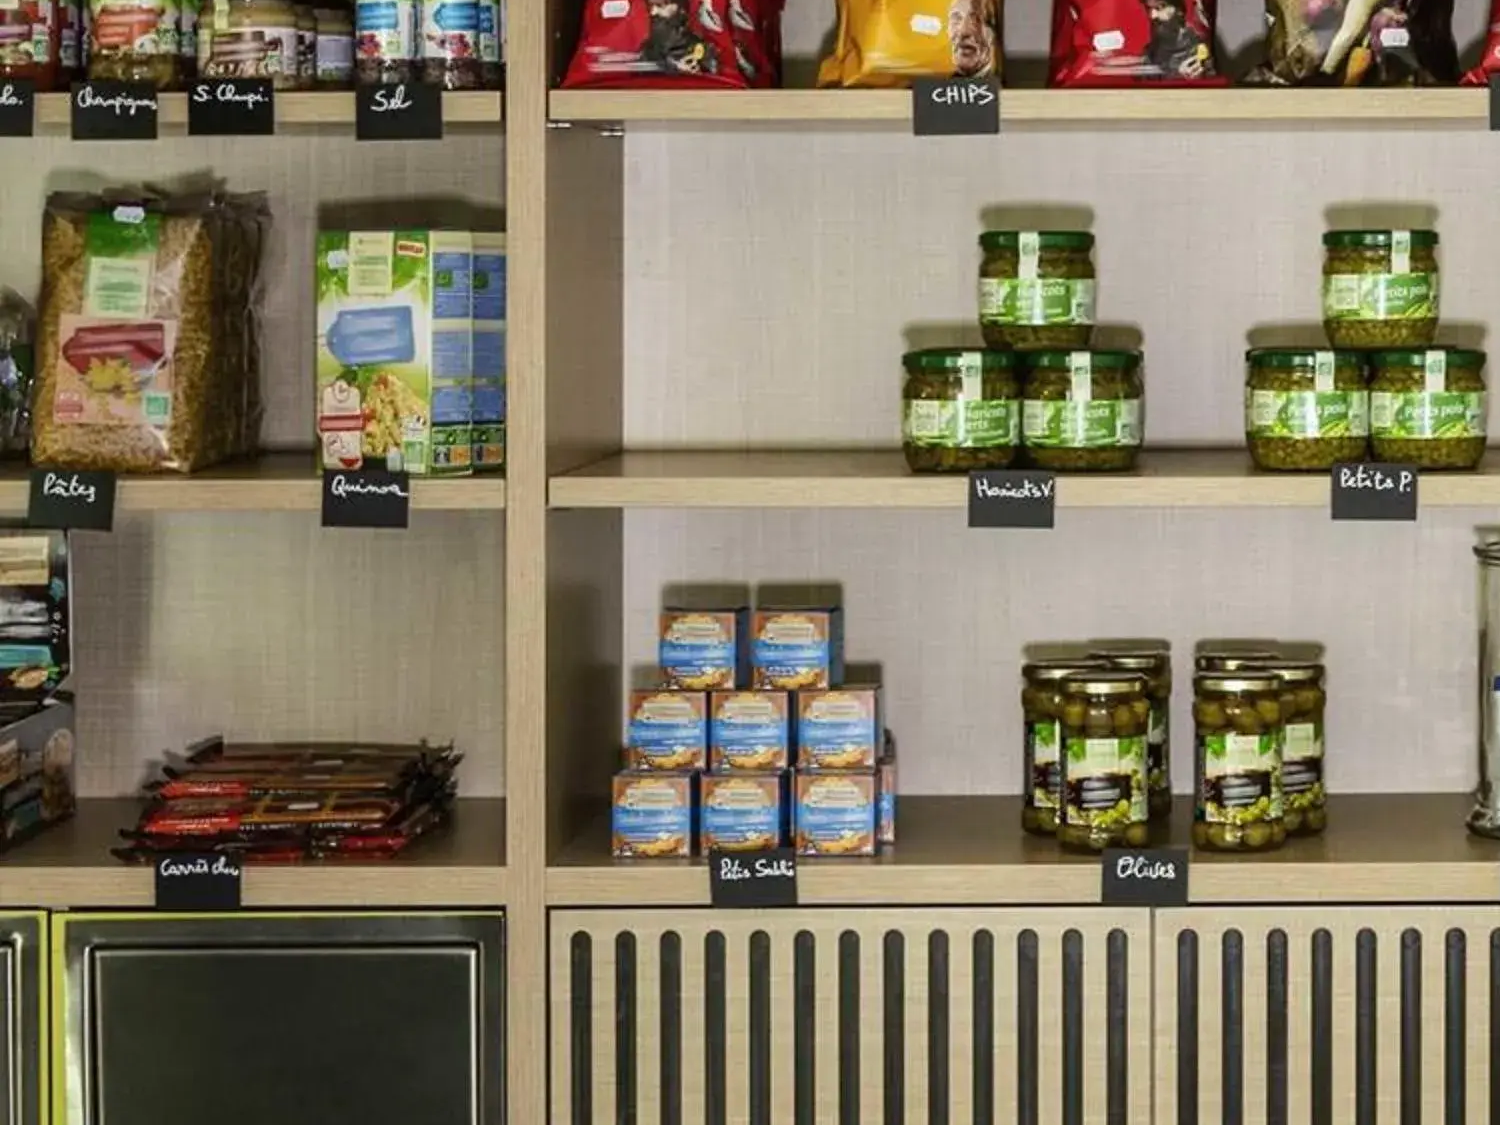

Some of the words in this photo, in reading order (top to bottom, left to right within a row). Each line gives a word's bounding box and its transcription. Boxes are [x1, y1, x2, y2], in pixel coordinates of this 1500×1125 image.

[370, 84, 413, 112] Sel
[931, 84, 995, 106] CHIPS
[331, 474, 409, 498] Quinoa
[1340, 465, 1394, 490] Petits
[1117, 856, 1176, 879] Olives
